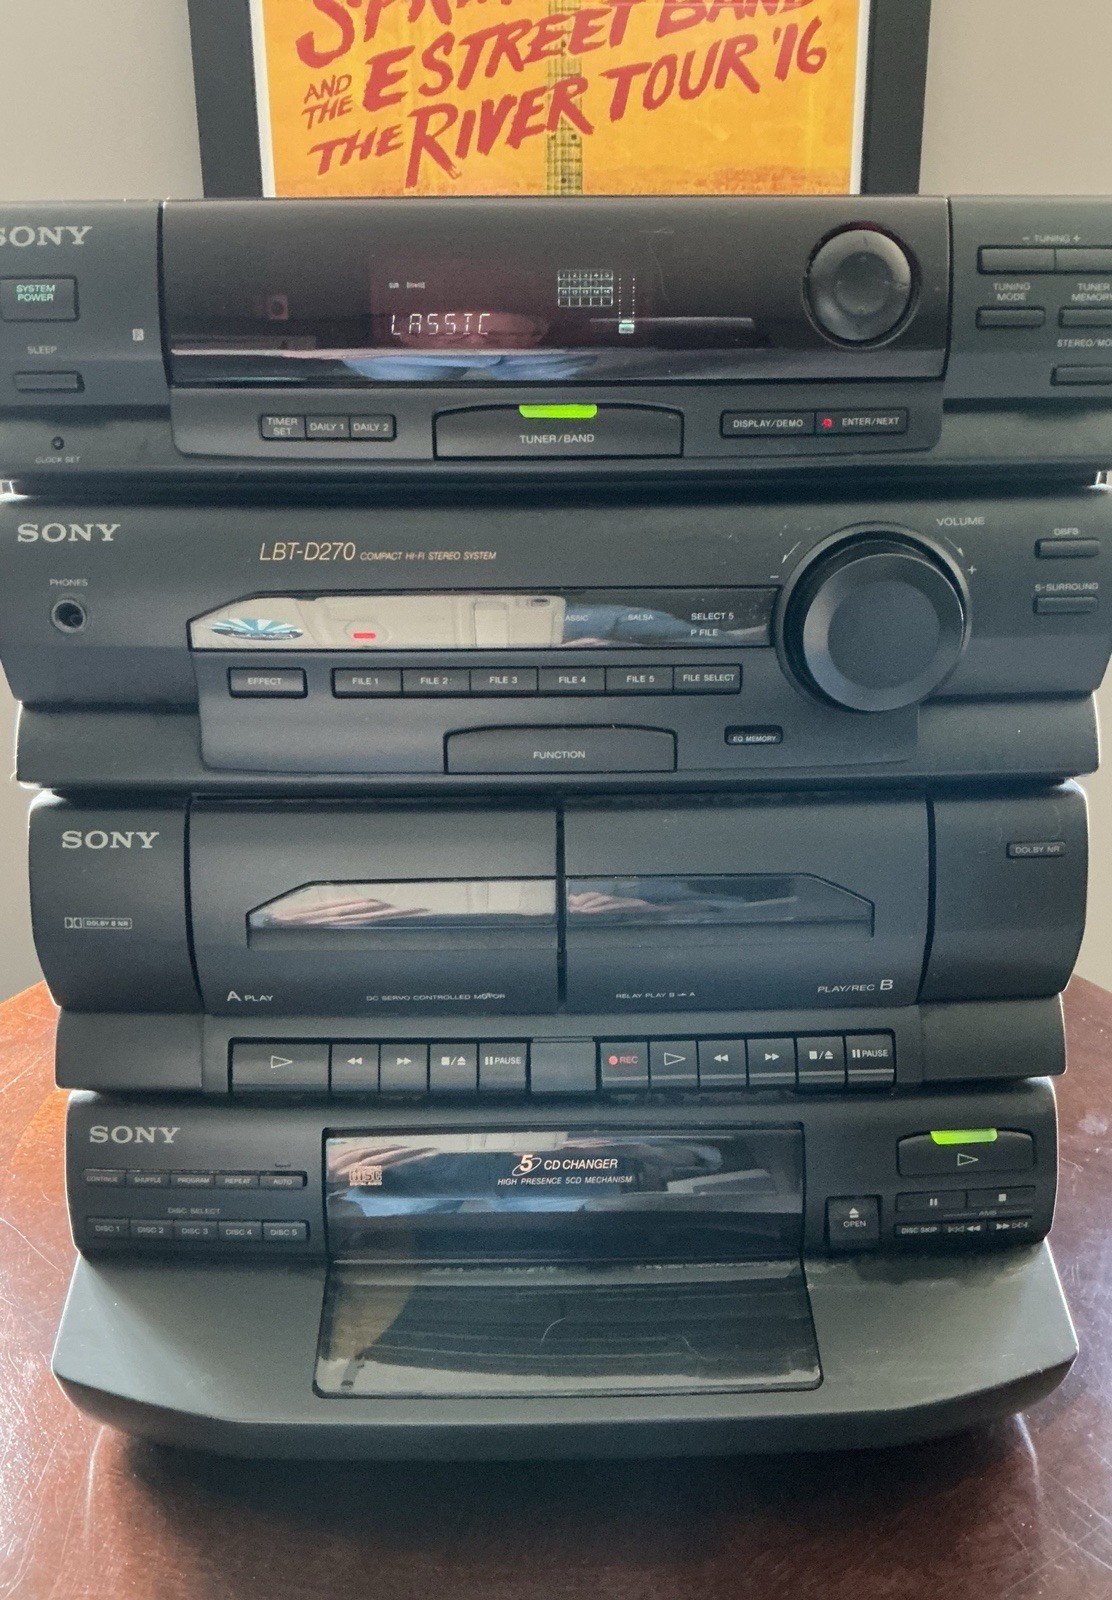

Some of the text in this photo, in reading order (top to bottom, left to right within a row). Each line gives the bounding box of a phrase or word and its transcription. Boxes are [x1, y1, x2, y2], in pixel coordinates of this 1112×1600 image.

[303, 74, 352, 104] AND
[307, 123, 404, 175] THE
[404, 76, 595, 188] RIVER
[599, 34, 760, 123] TOUR
[773, 16, 827, 81] '16
[301, 95, 353, 130] THE
[16, 284, 56, 293] SYSTEM
[993, 282, 1031, 290] TUNING
[1077, 282, 1110, 290] TUNER
[17, 293, 54, 301] POWER
[997, 292, 1026, 301] MODE
[391, 313, 490, 335] LASSIC
[27, 346, 57, 354] SLEEP
[266, 417, 298, 426] TIMER
[733, 419, 804, 428] DISPLAY/DEMO
[842, 417, 900, 426] ENTER/NEXT
[273, 427, 292, 436] SET
[310, 423, 337, 431] DAILY
[353, 423, 389, 431] DAILY 2
[520, 434, 595, 443] TUNER/BAND
[936, 517, 986, 526] VOLUME
[17, 523, 120, 542] SONY
[259, 542, 356, 561] LBT-D270
[360, 551, 402, 560] COMPACT
[428, 551, 461, 560] STEREO
[463, 551, 497, 560] SYSTEM
[1035, 583, 1099, 591] S-SURROUND
[691, 612, 734, 621] SELECT 5
[699, 629, 719, 637] FILE
[247, 677, 283, 685] EFFECT
[352, 677, 373, 685] FILE
[420, 677, 449, 685] FILE 2
[489, 676, 518, 684] FILE 3
[558, 676, 587, 684] FILE 4
[626, 675, 655, 683] FILE 5
[683, 674, 735, 682] FILE SELECT
[745, 735, 776, 743] MEMORY
[533, 751, 586, 759] FUNCTION
[62, 831, 160, 849] SONY
[817, 979, 894, 993] PLAY/REC B
[226, 990, 242, 1002] A
[861, 1049, 888, 1058] PAUSE
[494, 1056, 521, 1065] PAUSE
[619, 1056, 638, 1064] REC
[89, 1125, 181, 1144] SONY
[544, 1161, 560, 1170] CD
[563, 1159, 618, 1170] CHANGER
[273, 1178, 293, 1186] AUTO
[497, 1175, 632, 1185] HIGH PRESENCE 5CD MECHANISM
[95, 1225, 115, 1233] DISC
[137, 1226, 156, 1234] DISC
[225, 1228, 244, 1236] DISC
[902, 1225, 938, 1234] DISC SKIP
